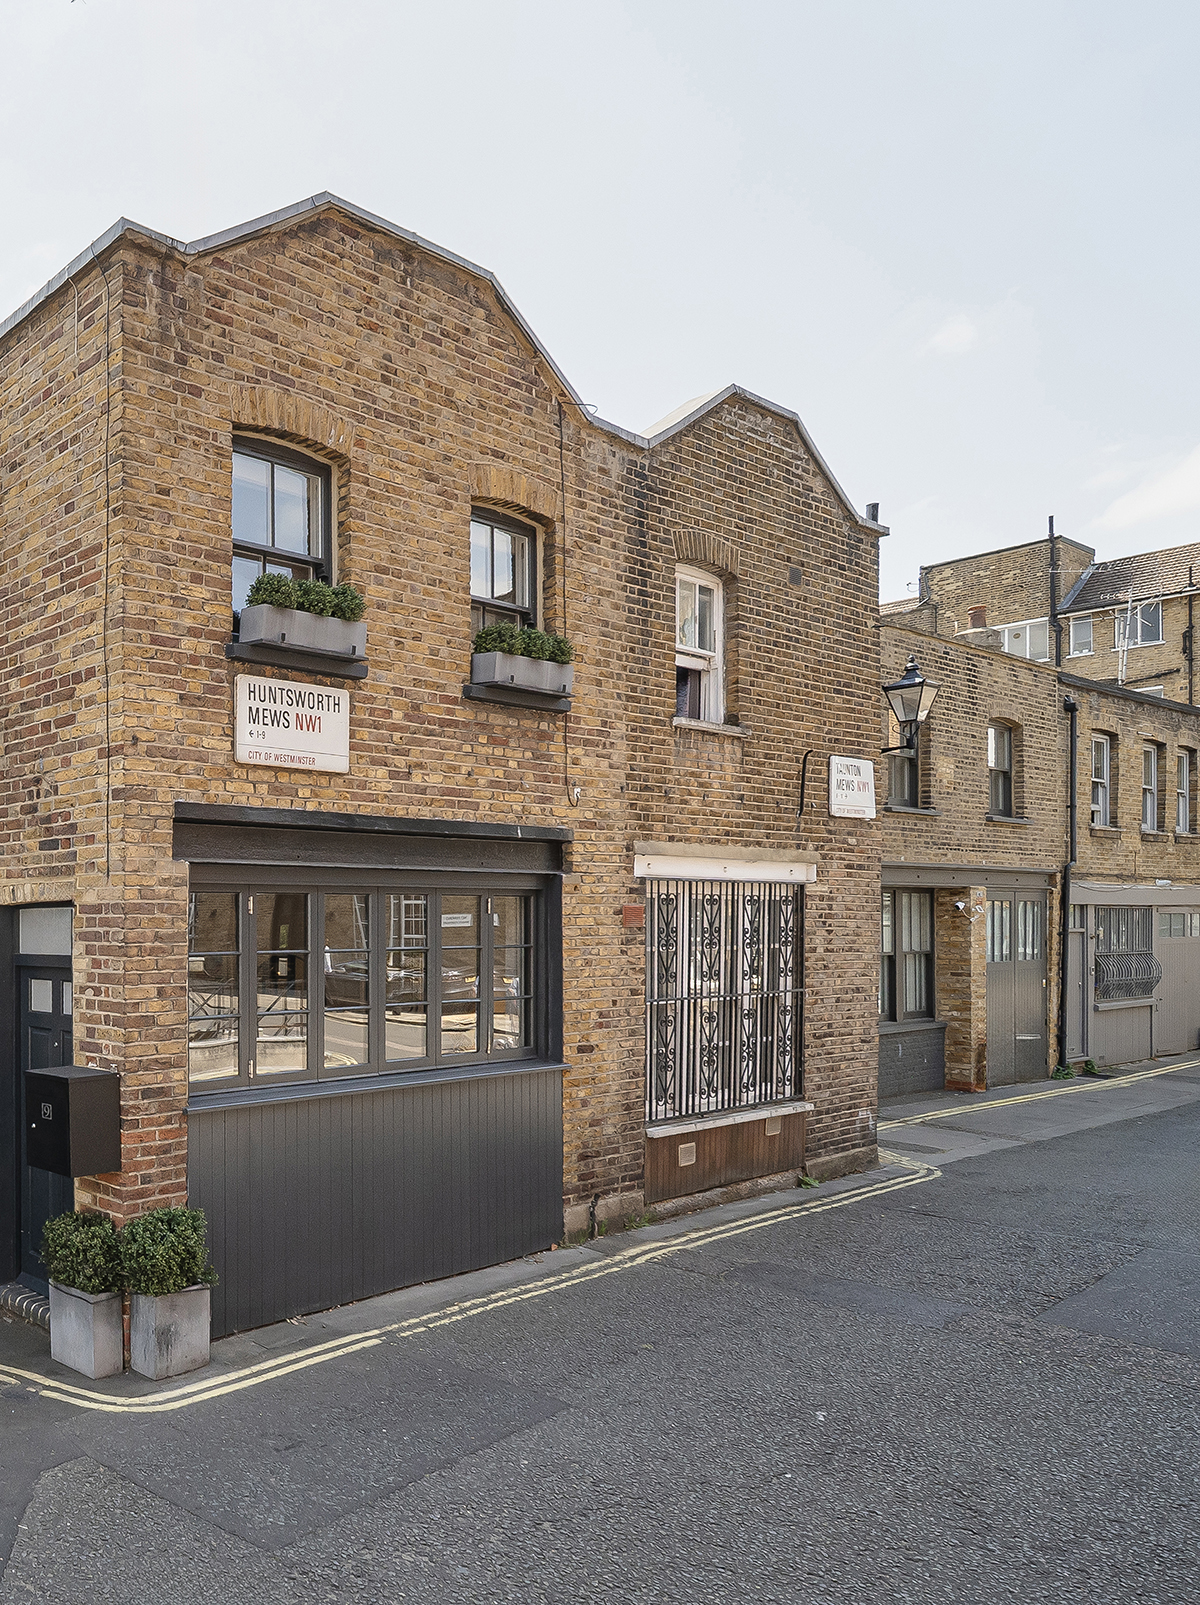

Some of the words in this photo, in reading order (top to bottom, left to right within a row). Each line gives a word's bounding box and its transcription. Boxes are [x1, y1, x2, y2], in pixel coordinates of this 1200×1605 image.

[248, 683, 341, 713] HUNTSWORTH
[248, 706, 290, 729] MEWS
[295, 713, 322, 733] NW1
[256, 730, 266, 740] 1-9
[248, 750, 262, 760] CITY
[264, 752, 272, 761] OF
[274, 753, 316, 766] WESTMINSTER
[835, 762, 861, 777] TAUNTON
[836, 778, 855, 791] MEWS
[856, 780, 870, 793] NW1
[43, 1105, 50, 1117] 9
